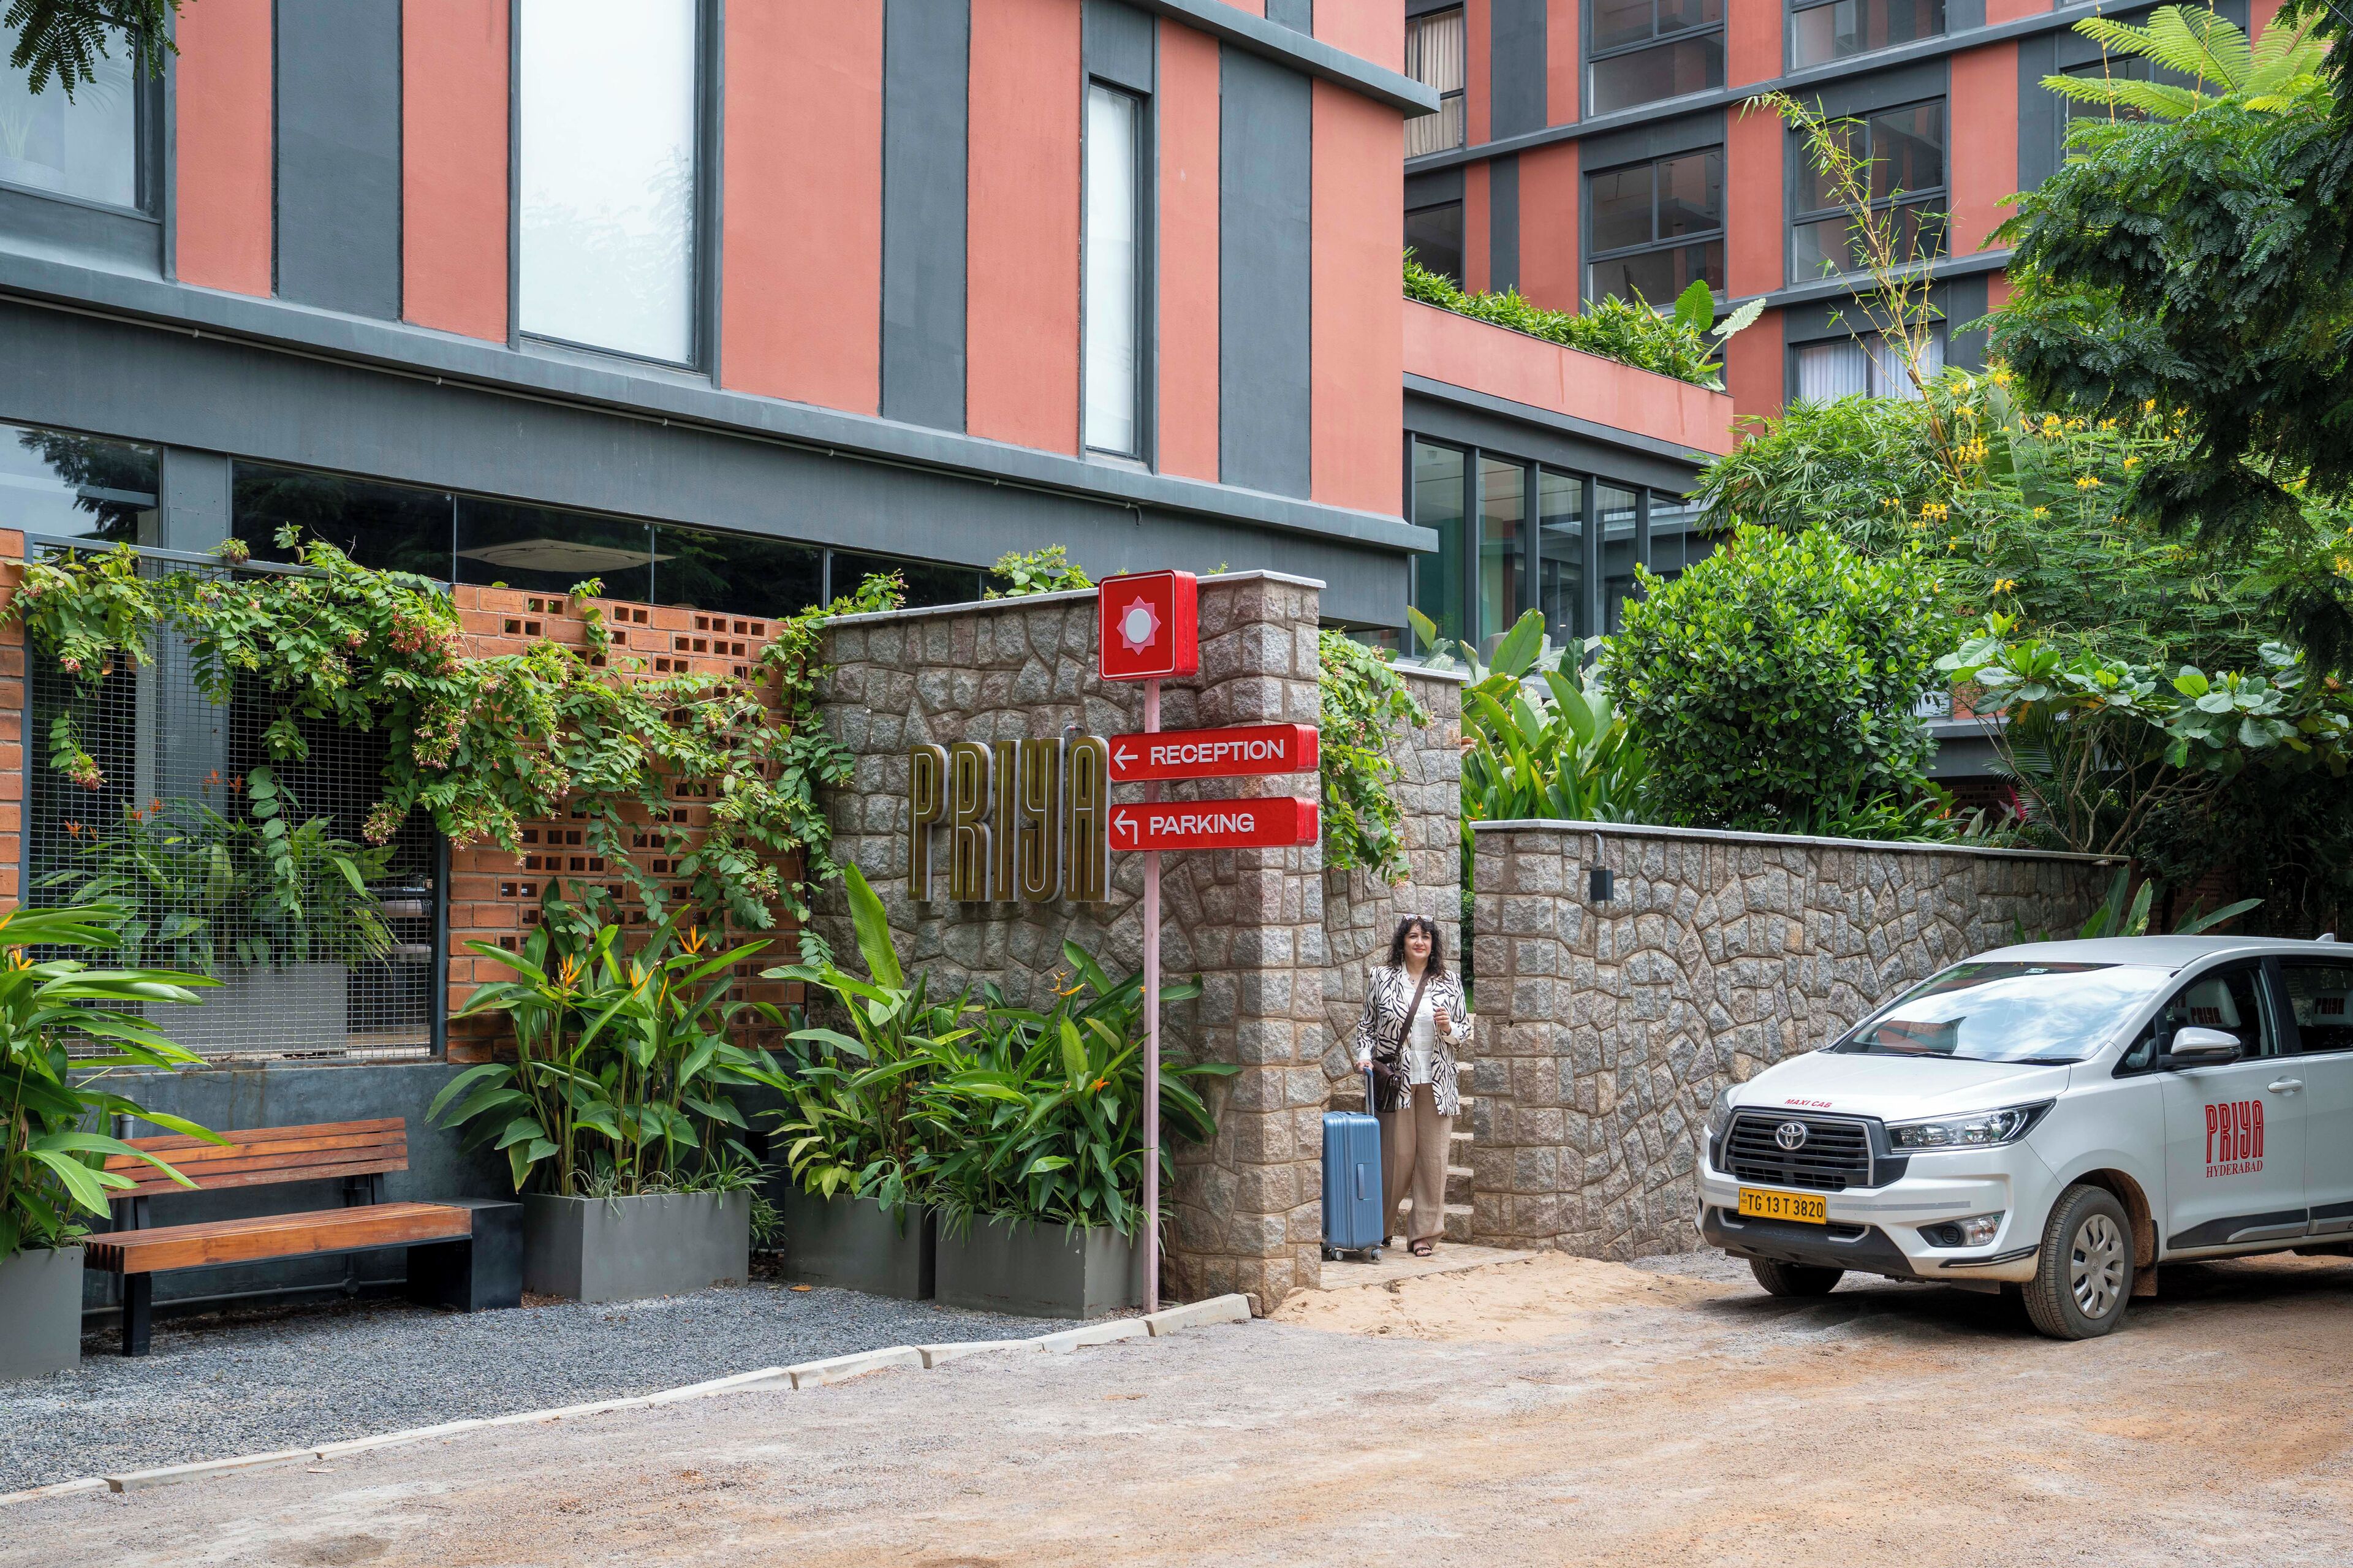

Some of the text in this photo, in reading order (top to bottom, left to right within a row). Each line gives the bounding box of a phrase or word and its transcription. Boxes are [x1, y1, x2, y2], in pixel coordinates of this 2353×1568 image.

[1150, 739, 1284, 765] RECEPTION
[907, 735, 1112, 903] PRIYA
[1150, 813, 1255, 835] PARKING
[2190, 1006, 2222, 1025] PRIYA
[2205, 1100, 2264, 1164] PRIYA
[2205, 1160, 2263, 1178] HYDERABAD
[1748, 1194, 1824, 1218] TG 13 T 3820
